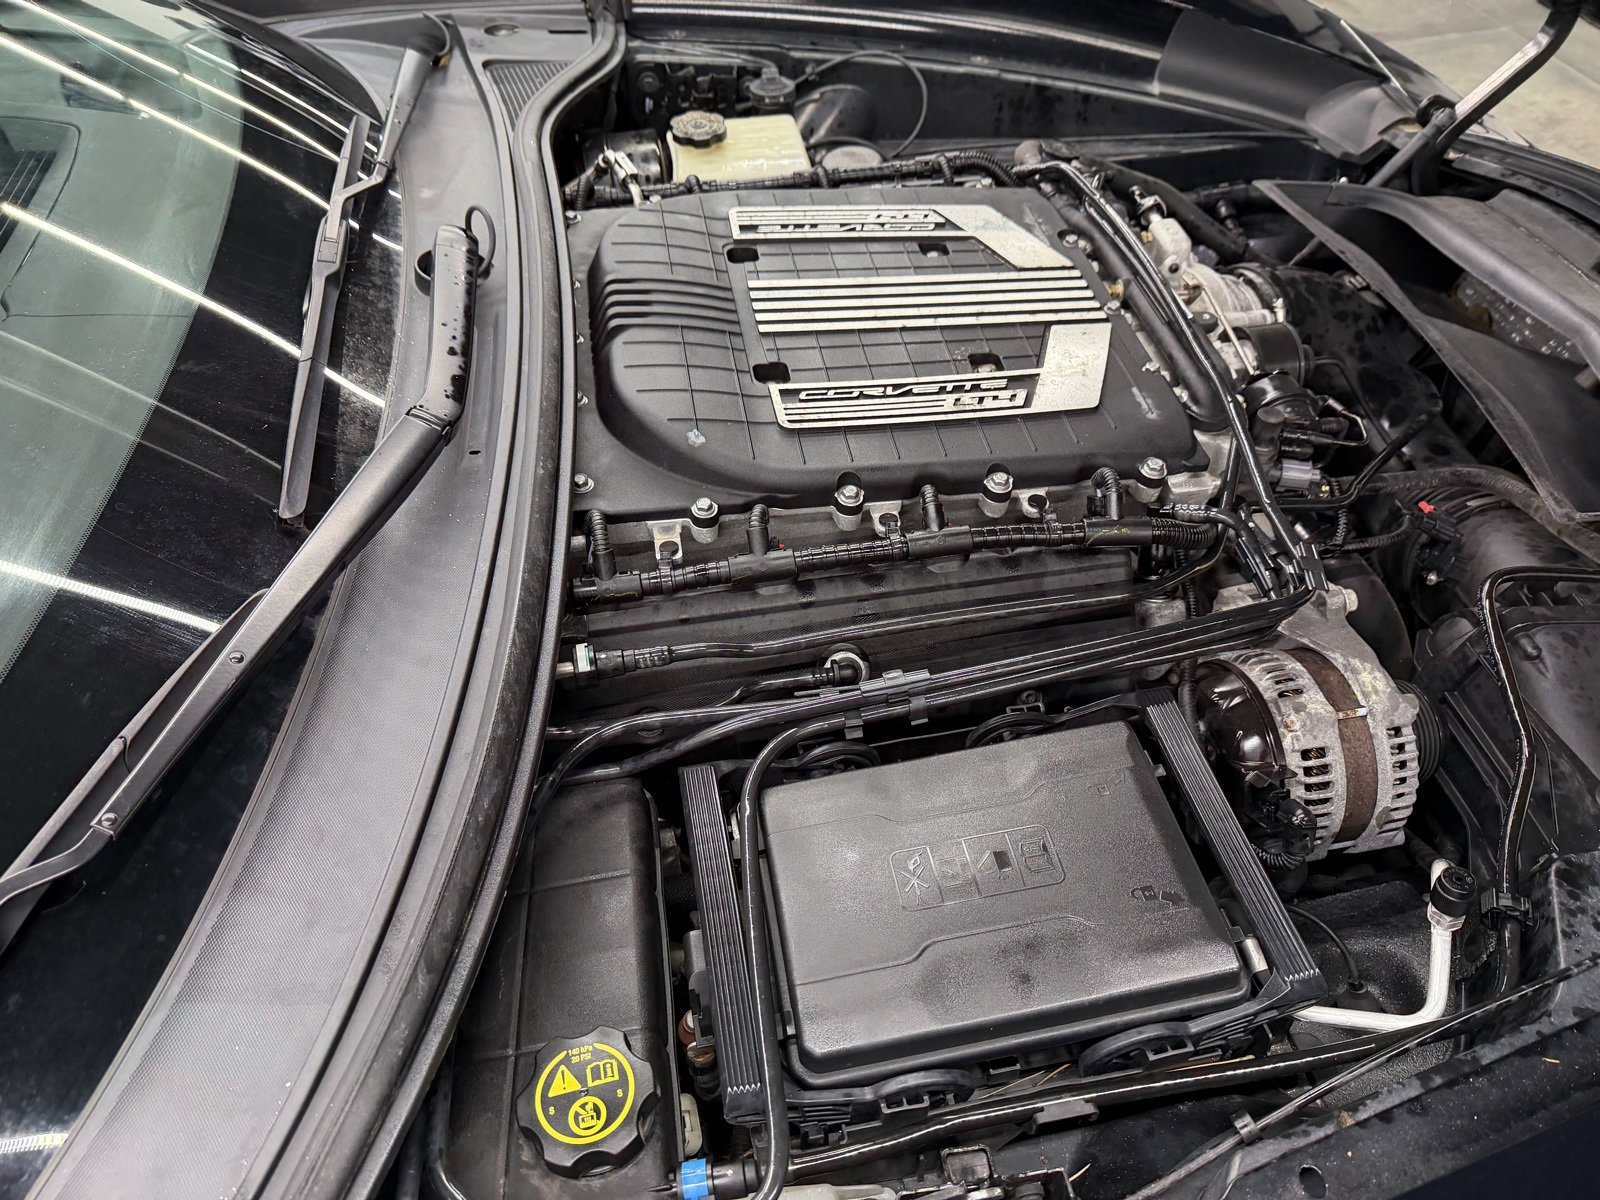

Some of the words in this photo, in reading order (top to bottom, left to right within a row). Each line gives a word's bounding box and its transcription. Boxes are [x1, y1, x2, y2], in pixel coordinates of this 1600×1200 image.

[756, 223, 935, 233] CORVETTE
[799, 378, 1008, 400] CORVETTE
[950, 391, 1019, 407] LT4
[568, 1047, 580, 1056] 140
[580, 1045, 593, 1053] kPa
[571, 1055, 580, 1063] 20
[580, 1052, 592, 1061] PSI
